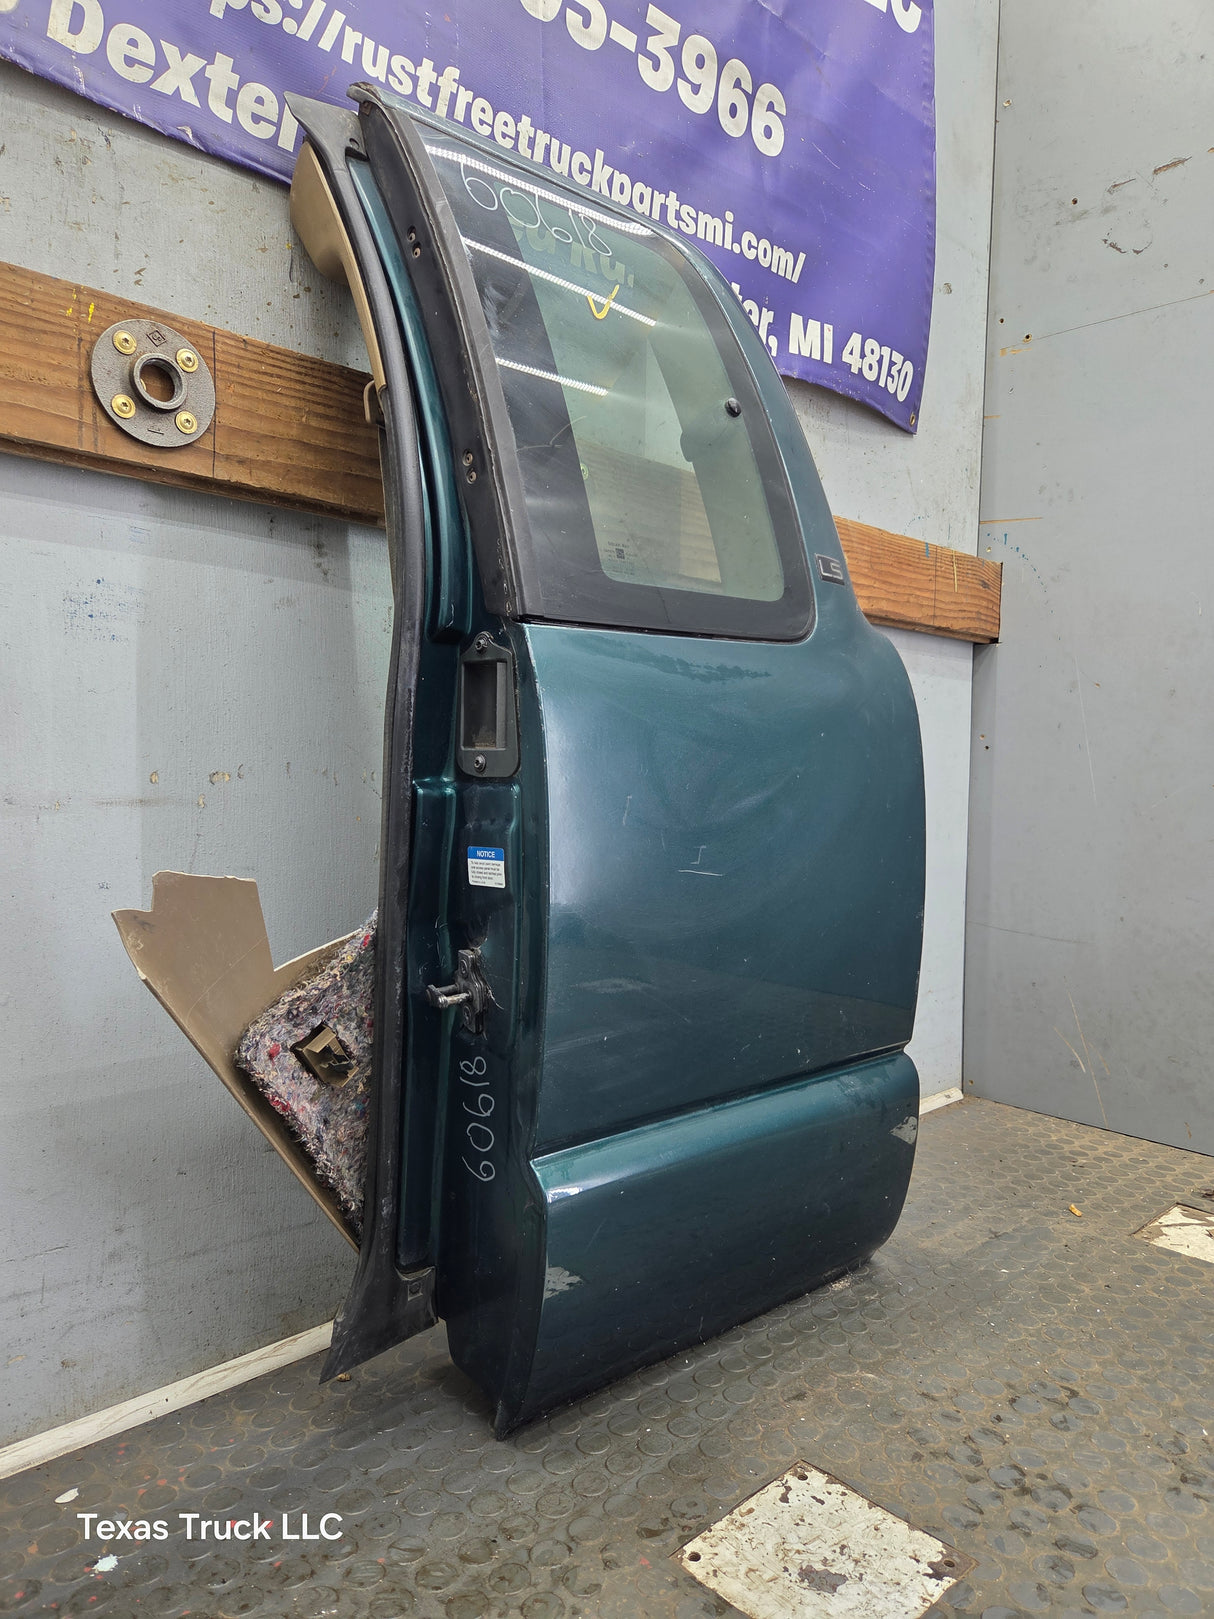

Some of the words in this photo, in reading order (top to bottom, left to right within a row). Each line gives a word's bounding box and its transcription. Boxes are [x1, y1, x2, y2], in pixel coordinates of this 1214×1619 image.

[788, 312, 833, 365] MI
[842, 332, 913, 402] 48130
[476, 850, 496, 859] NOTICE
[459, 1056, 496, 1182] 60618
